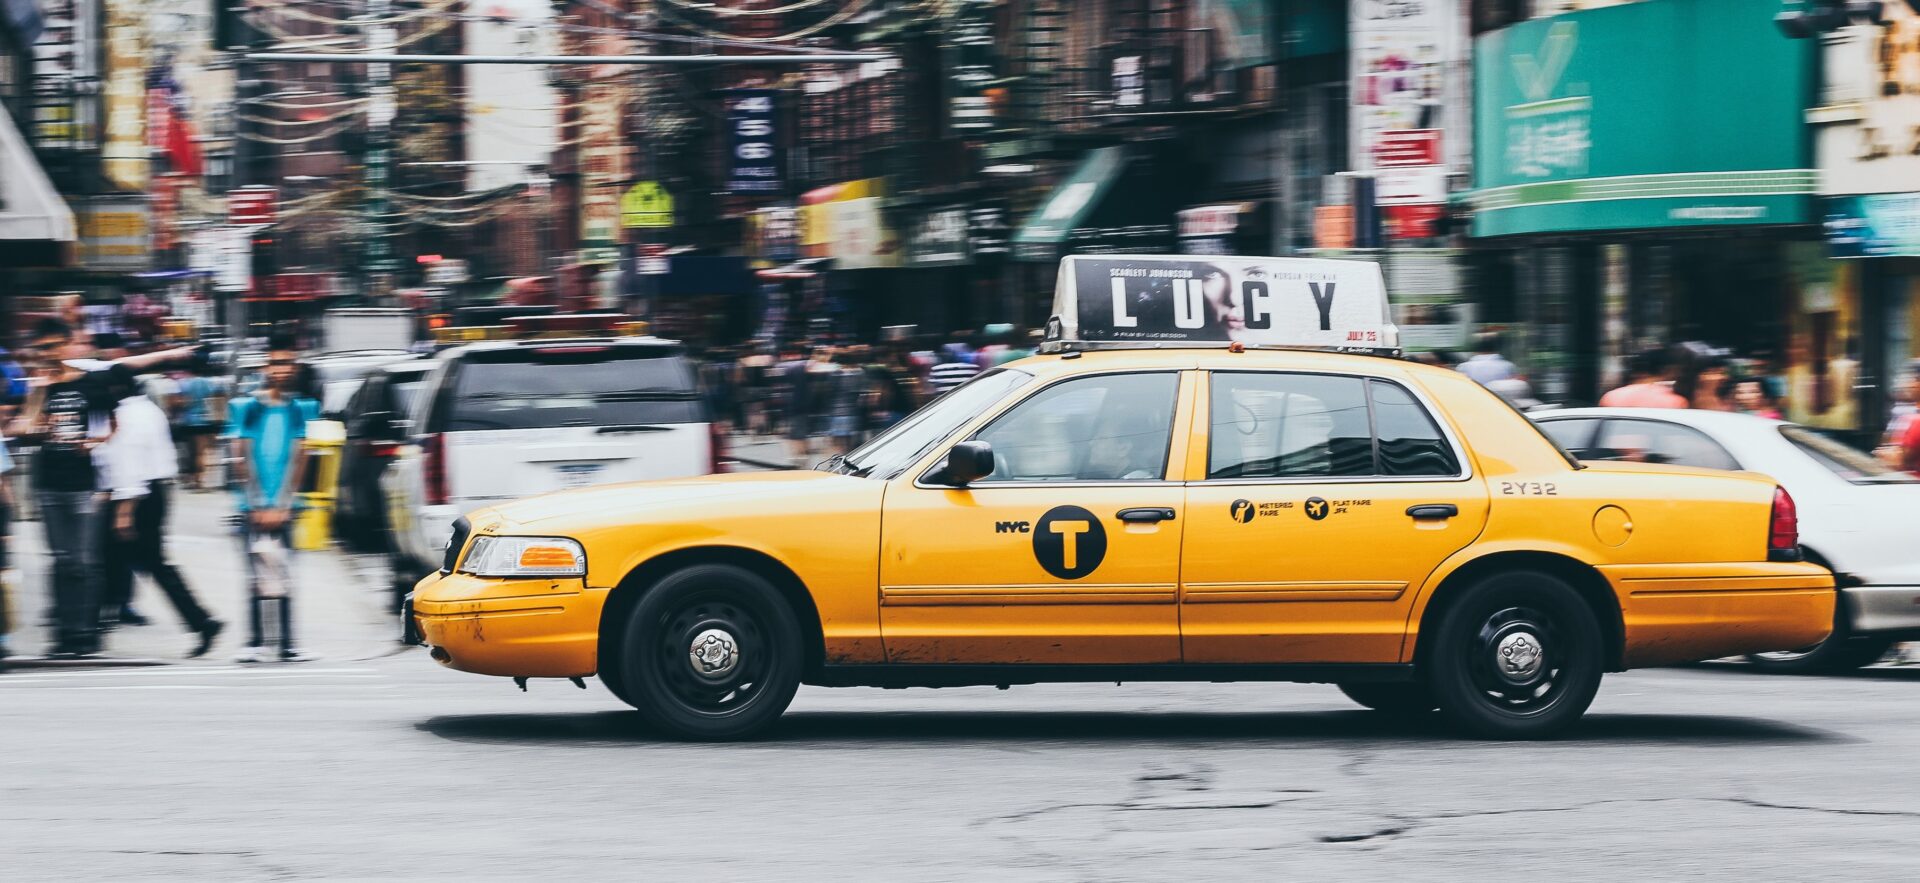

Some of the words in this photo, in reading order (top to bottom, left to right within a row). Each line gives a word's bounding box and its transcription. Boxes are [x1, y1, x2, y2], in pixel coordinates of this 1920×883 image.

[1347, 331, 1364, 341] JULY
[1501, 481, 1558, 496] 2Y32
[1259, 502, 1294, 510] METERED
[1332, 499, 1350, 508] FLAT
[1352, 499, 1372, 507] FARE
[1259, 509, 1280, 517] FARE
[1334, 507, 1348, 515] JFK
[995, 520, 1030, 534] NYC
[1049, 520, 1090, 570] T
